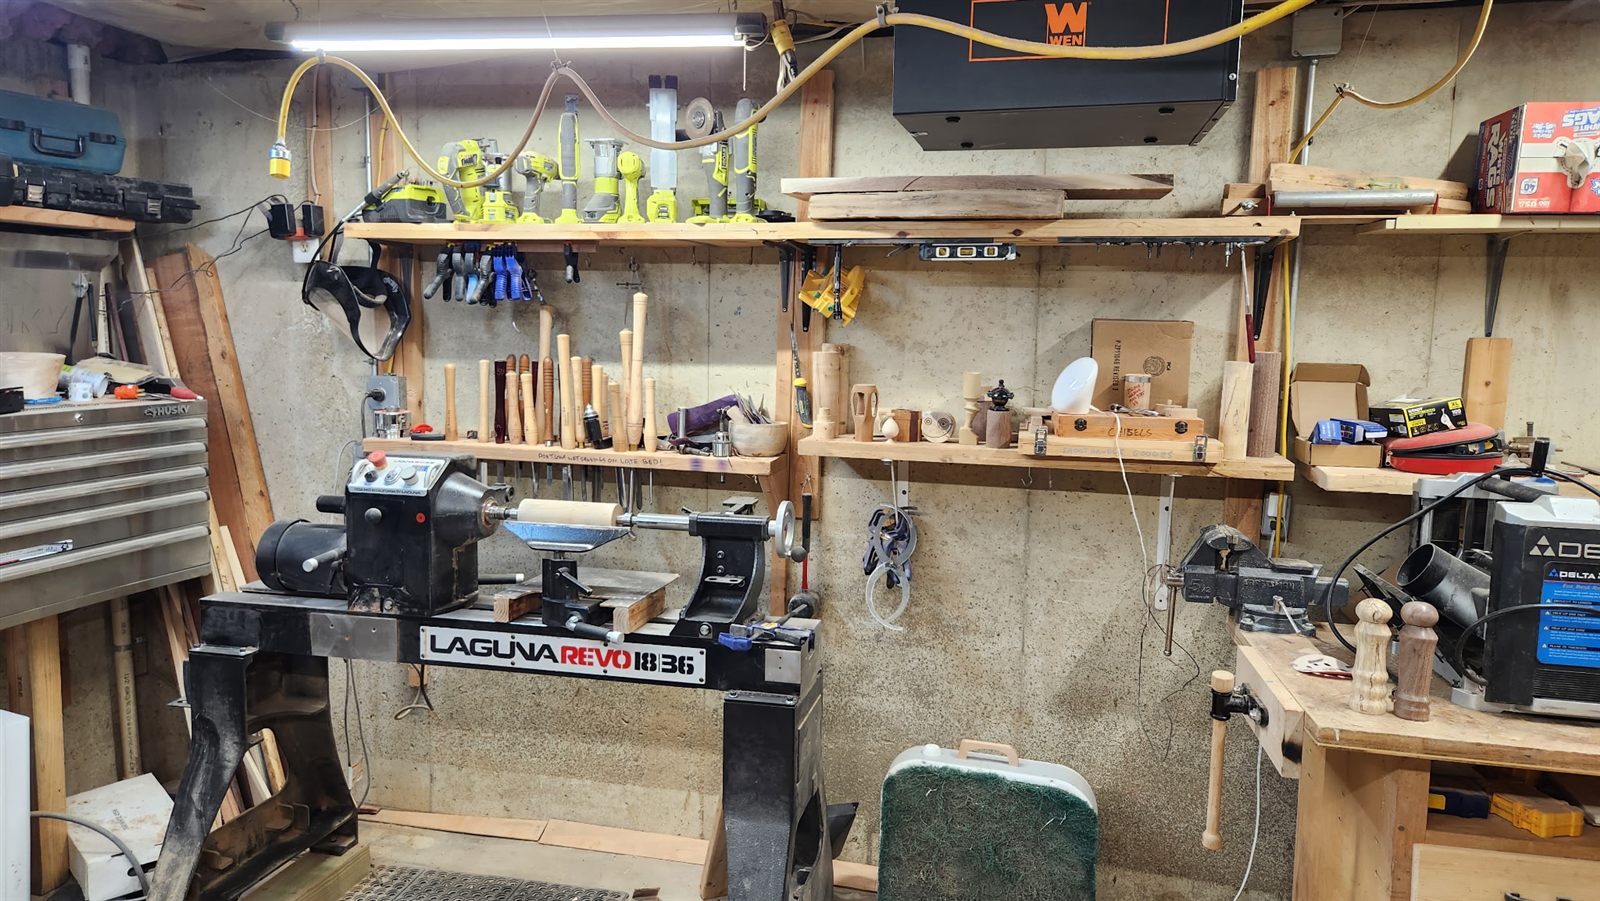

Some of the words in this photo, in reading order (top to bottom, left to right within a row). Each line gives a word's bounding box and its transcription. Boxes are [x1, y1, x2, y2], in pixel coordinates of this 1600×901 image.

[1049, 34, 1083, 46] WEN
[1486, 121, 1501, 208] RAGS
[1523, 183, 1536, 192] 40
[157, 404, 190, 416] HUSKY
[1559, 571, 1596, 579] DELTA
[430, 634, 559, 664] LAGUNA
[560, 645, 632, 670] REVO
